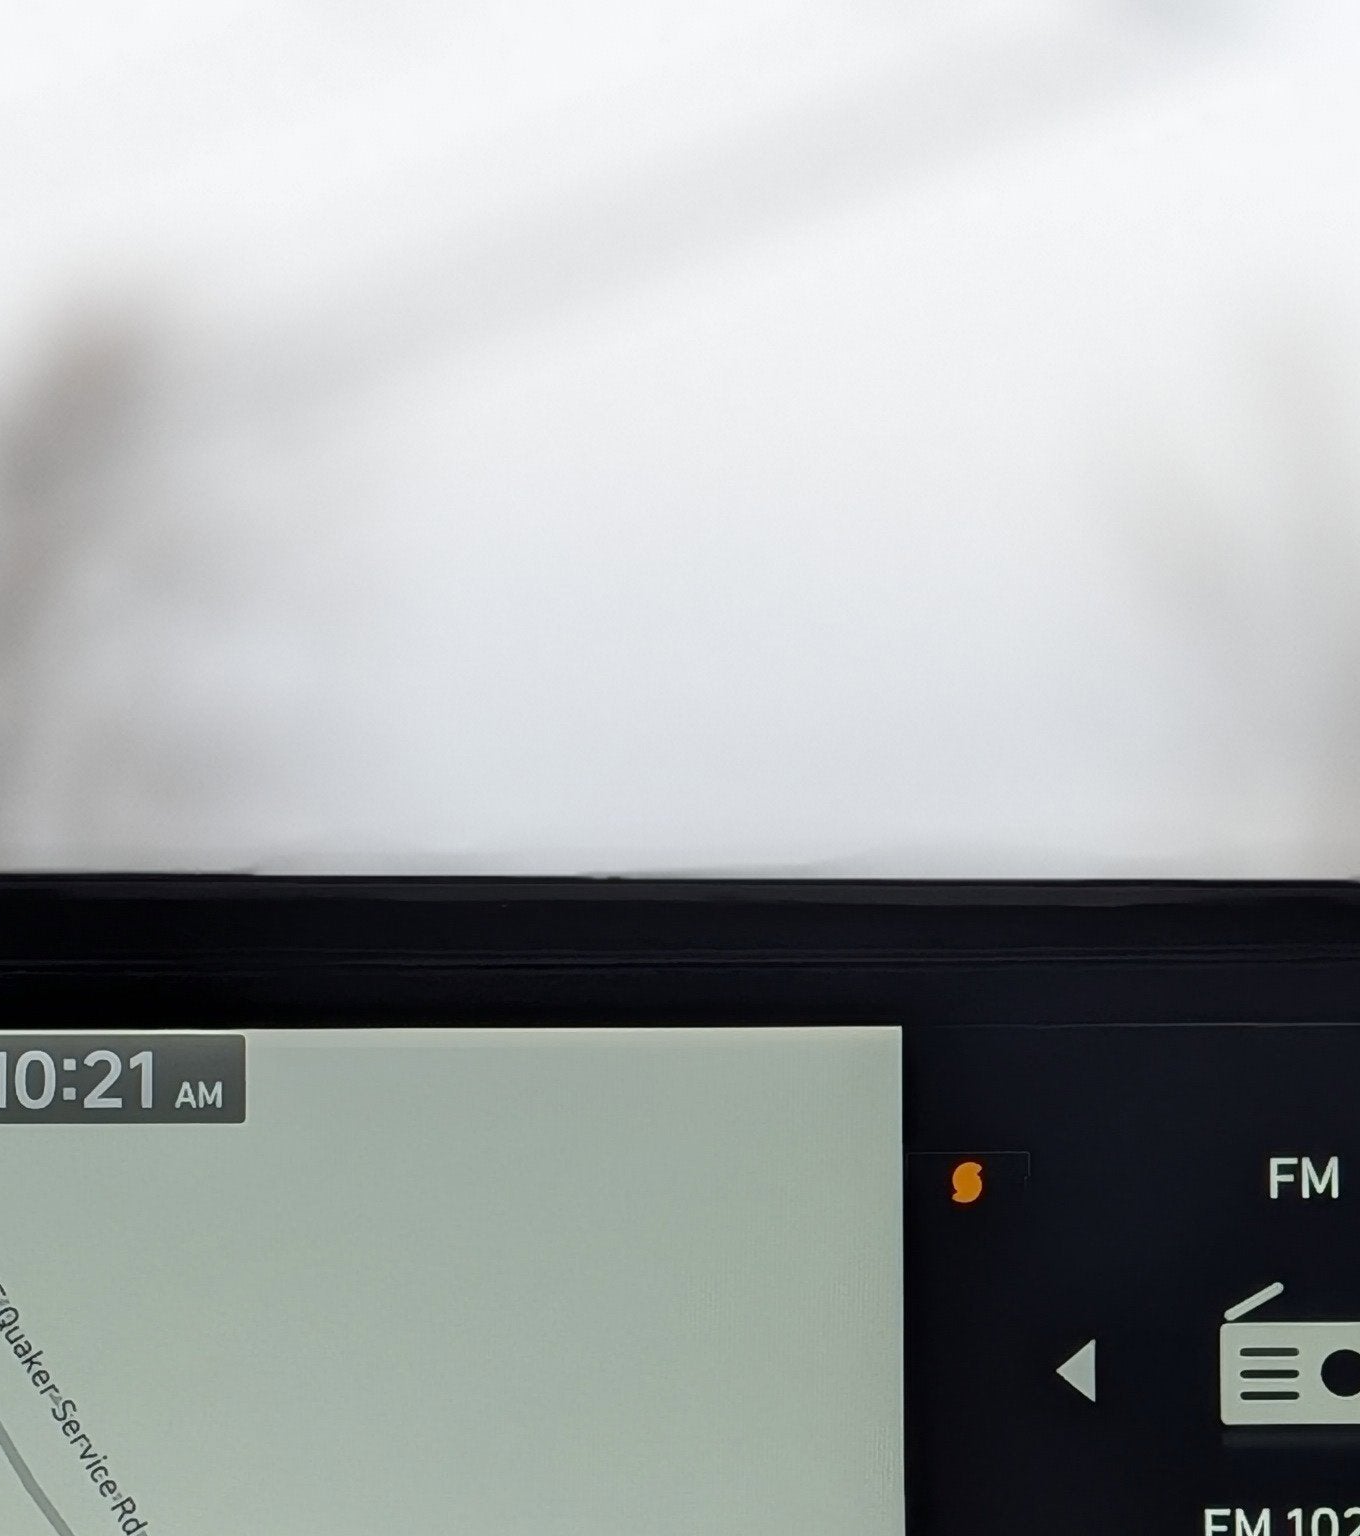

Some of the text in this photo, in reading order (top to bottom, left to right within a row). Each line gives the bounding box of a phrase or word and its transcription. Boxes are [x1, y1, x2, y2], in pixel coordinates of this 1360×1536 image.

[173, 1080, 223, 1109] AM
[1269, 1156, 1340, 1199] FM
[51, 1399, 118, 1498] Service
[110, 1496, 149, 1536] Rd
